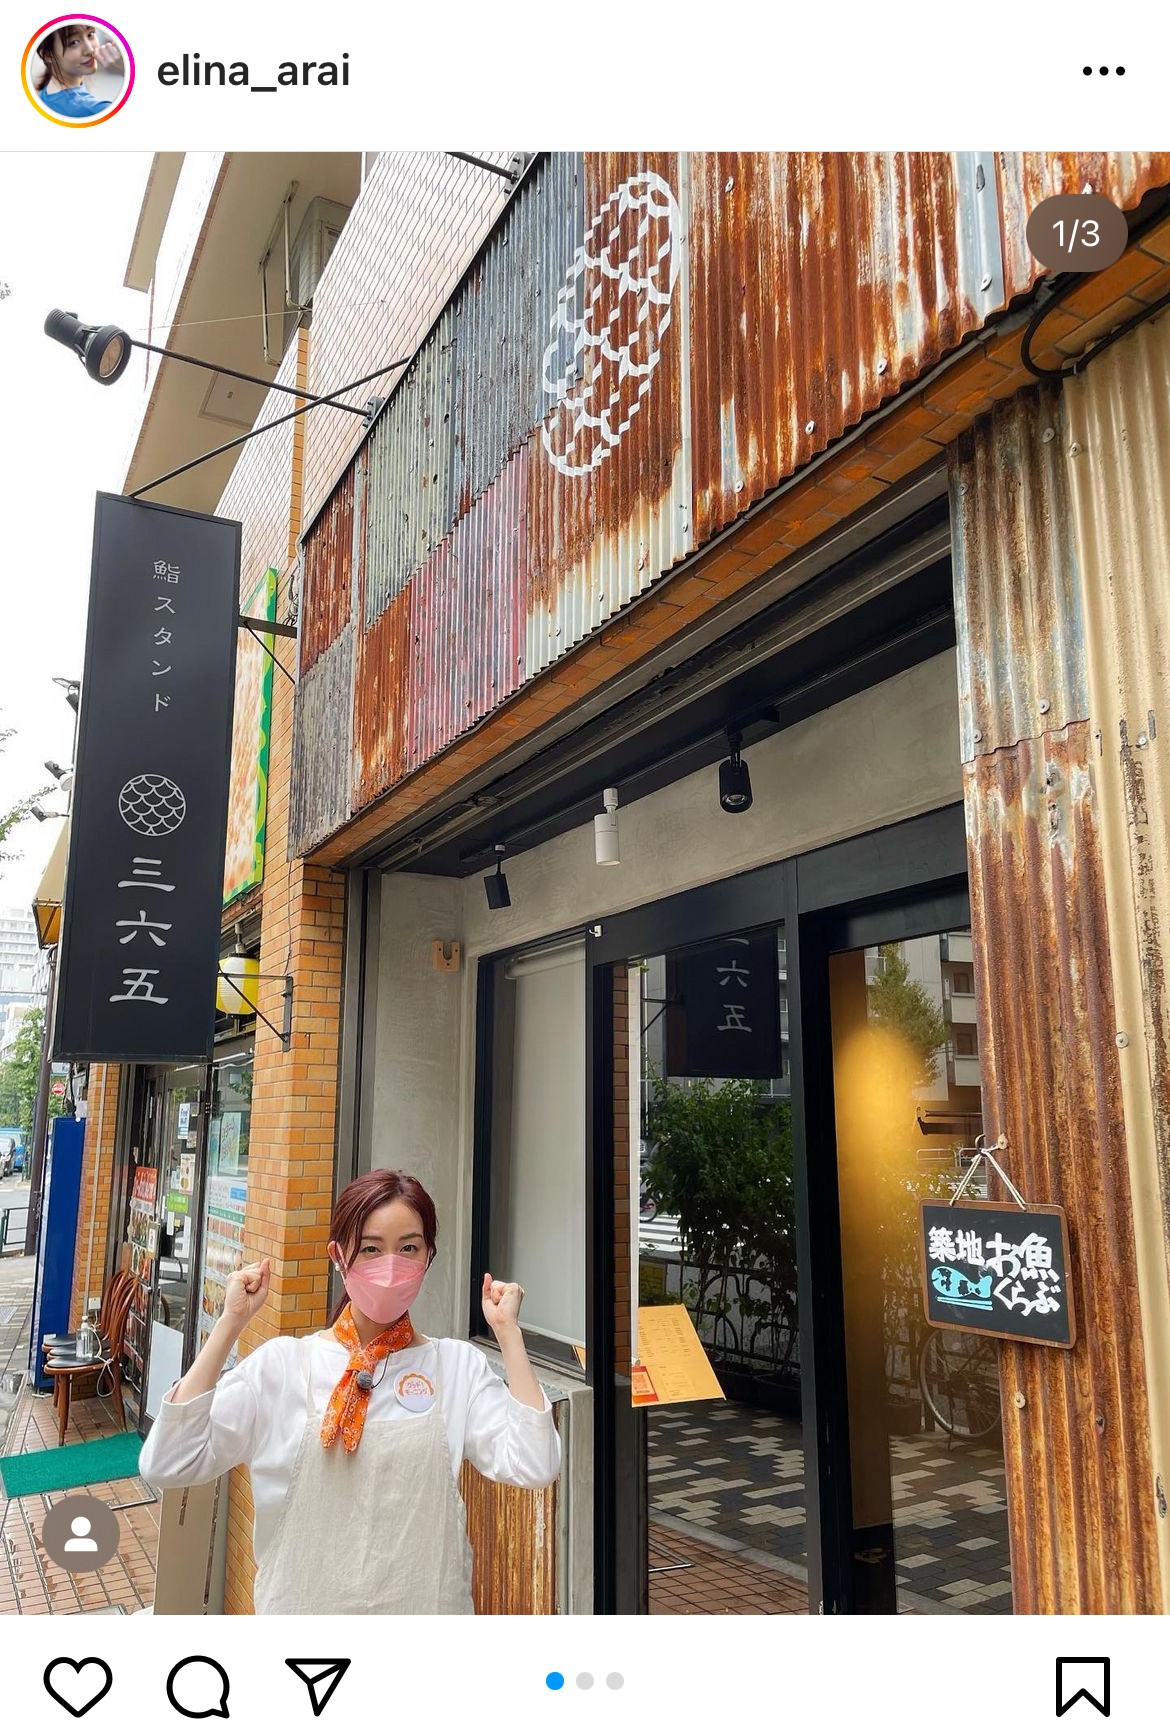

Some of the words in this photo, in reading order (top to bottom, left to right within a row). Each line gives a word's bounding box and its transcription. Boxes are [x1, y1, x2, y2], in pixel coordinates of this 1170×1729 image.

[151, 558, 181, 713] 鮨スタンド
[109, 855, 176, 1006] 三六五
